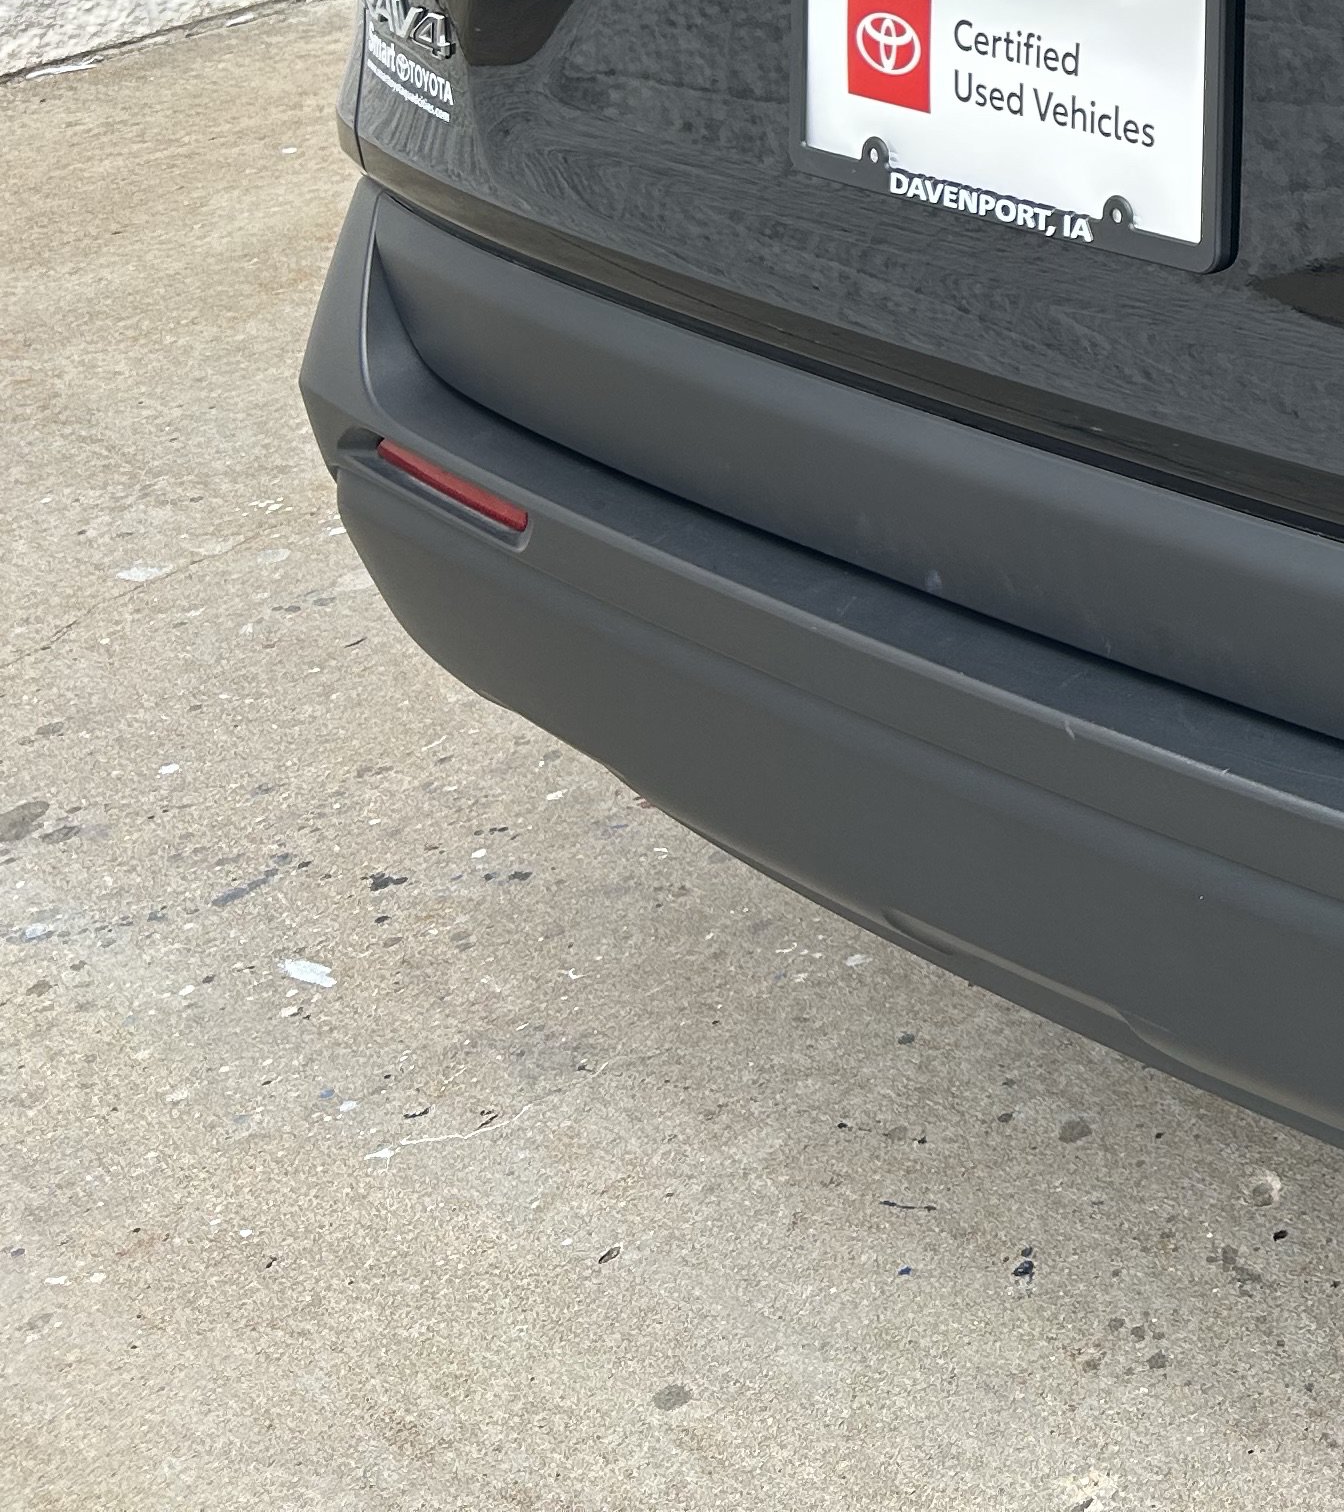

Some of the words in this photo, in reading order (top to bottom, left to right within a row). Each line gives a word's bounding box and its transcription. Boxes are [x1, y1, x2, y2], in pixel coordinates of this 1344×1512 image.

[368, 20, 396, 73] Smart
[408, 59, 454, 106] TOYOTA
[953, 19, 1081, 77] Certified
[953, 68, 1025, 117] Used
[1032, 87, 1155, 148] Vehicles
[889, 171, 1057, 237] DAVENPORT,
[1063, 214, 1095, 243] IA
